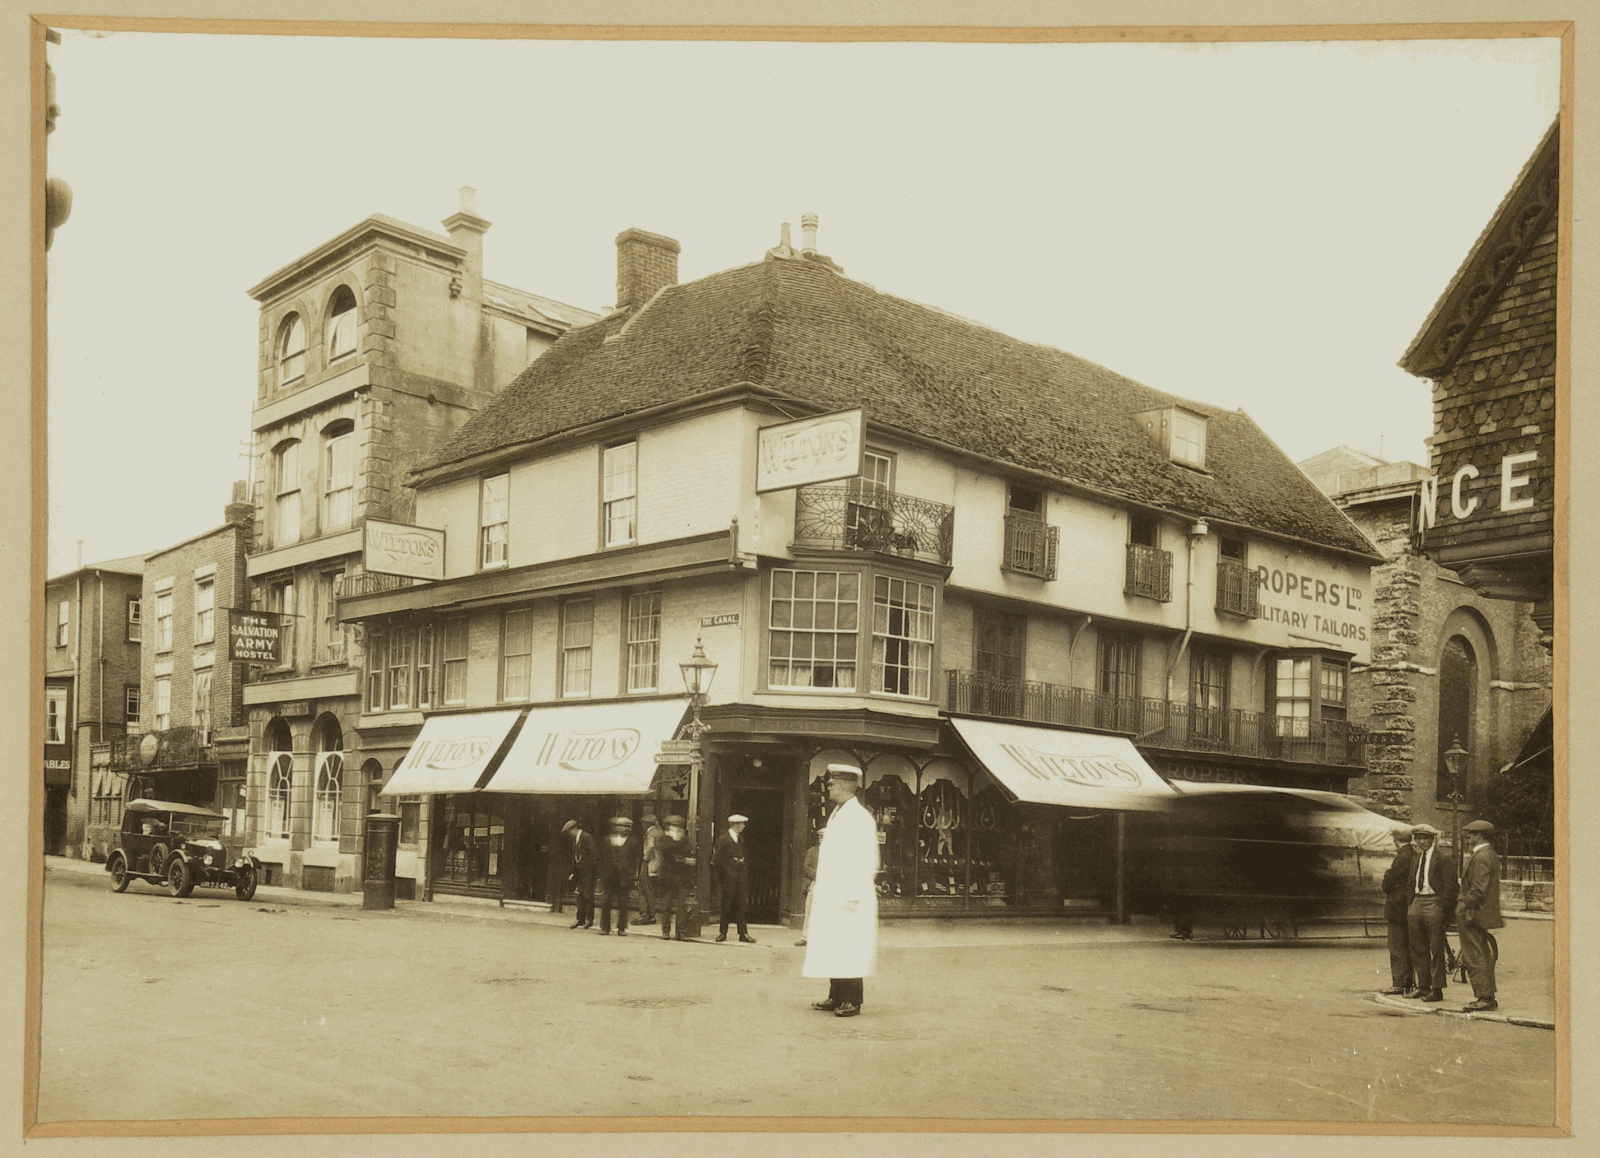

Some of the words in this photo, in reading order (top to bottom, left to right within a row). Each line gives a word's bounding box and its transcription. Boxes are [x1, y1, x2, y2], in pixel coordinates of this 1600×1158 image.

[241, 616, 268, 626] THE
[714, 614, 738, 625] CANAL
[1258, 603, 1308, 629] ILITARY
[231, 624, 278, 638] SALVATION
[235, 637, 274, 650] ARMY
[235, 649, 276, 660] HOSTEL
